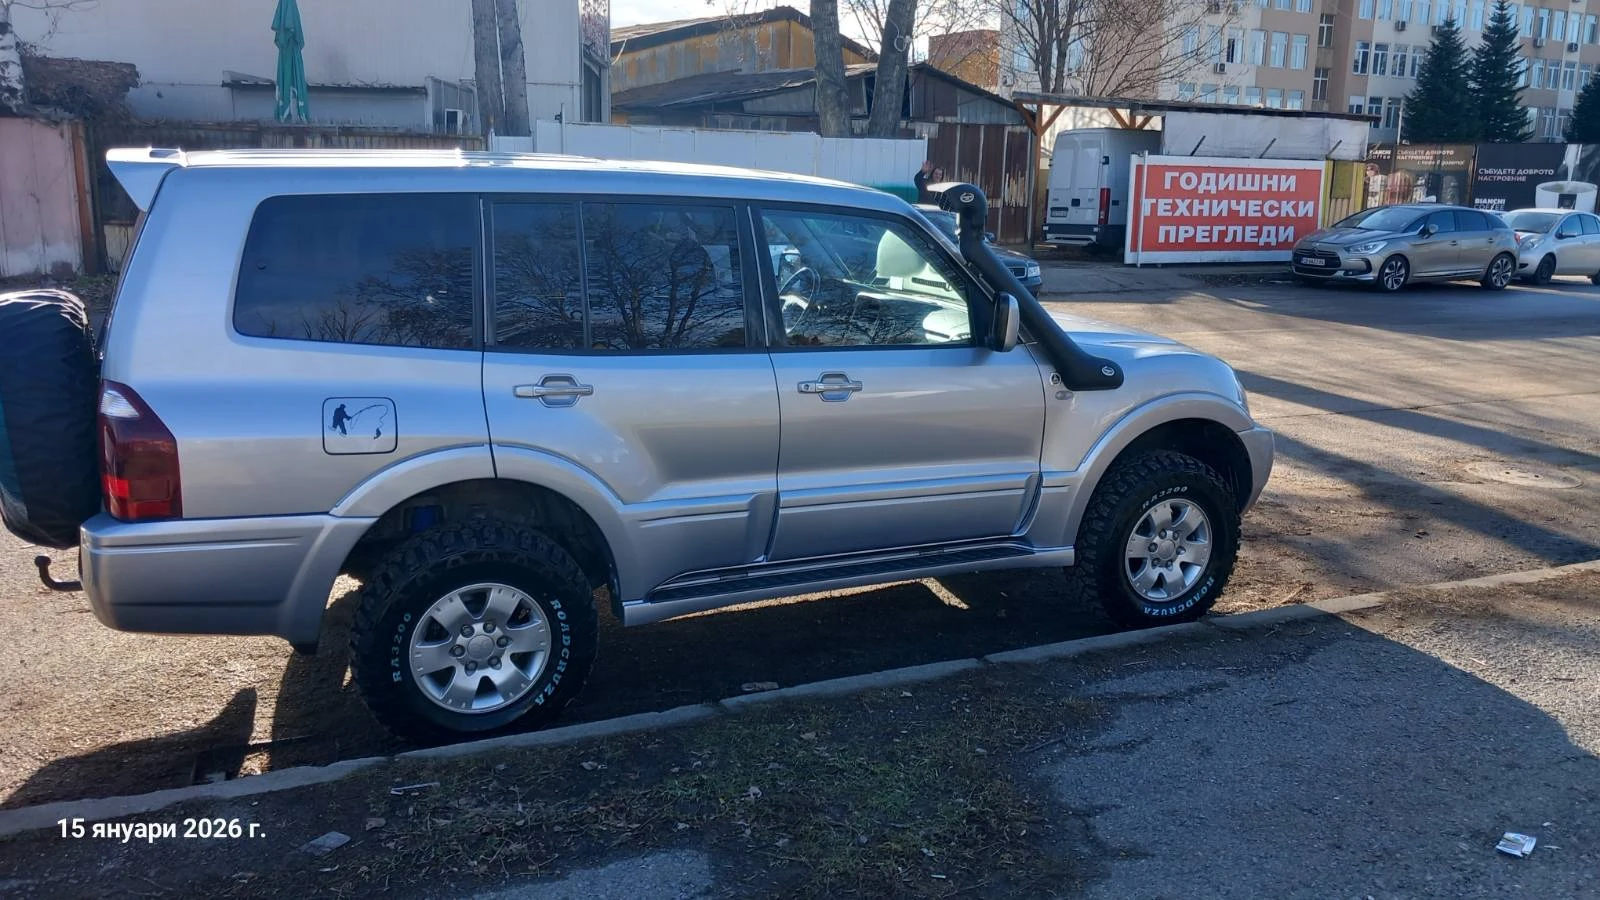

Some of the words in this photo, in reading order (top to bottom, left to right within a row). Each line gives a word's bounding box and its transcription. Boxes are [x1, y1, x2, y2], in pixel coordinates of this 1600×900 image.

[1164, 171, 1297, 194] ГОДИШНИ
[1142, 198, 1315, 218] ТЕХНИЧЕСКИ
[1158, 225, 1295, 246] ПРЕГЛЕДИ
[1143, 575, 1215, 616] ROADCRUZA
[391, 612, 412, 682] RA3200
[534, 598, 571, 707] ROADCRUZA
